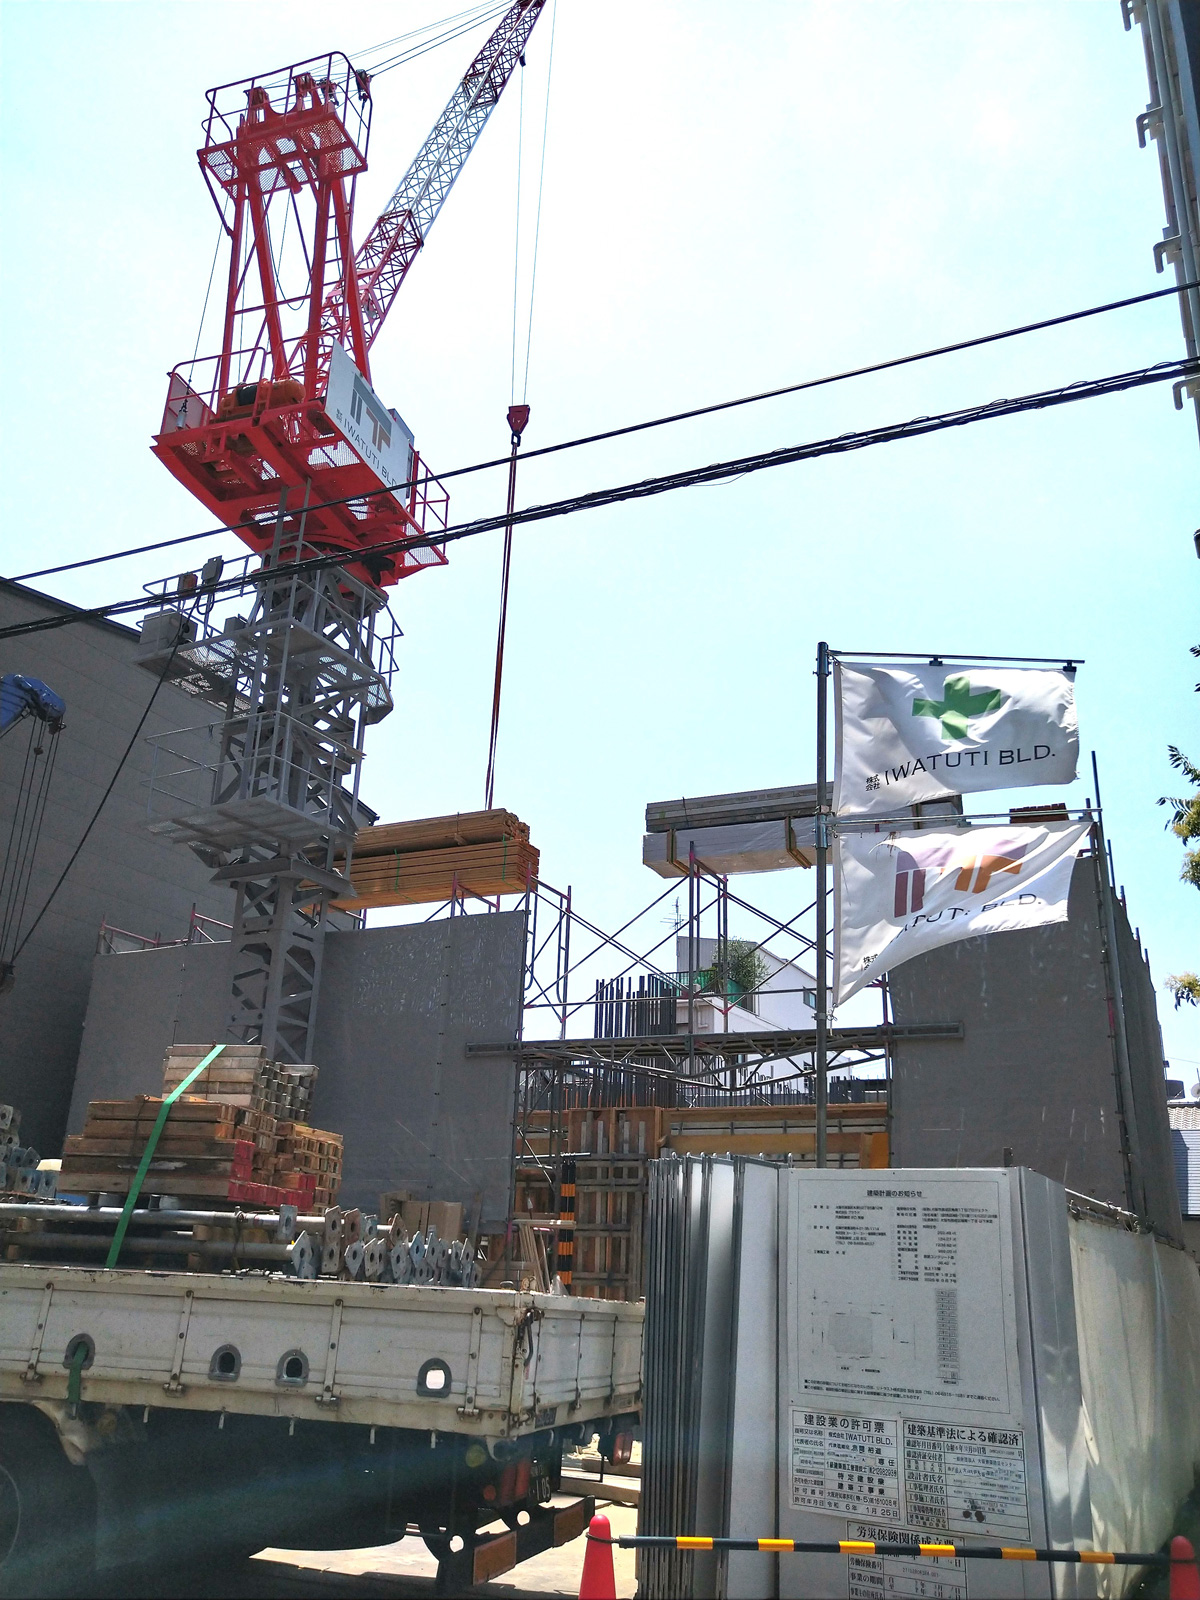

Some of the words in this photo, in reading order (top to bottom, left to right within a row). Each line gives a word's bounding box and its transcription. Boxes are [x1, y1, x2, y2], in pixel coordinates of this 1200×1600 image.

[344, 418, 380, 470] IWATUTI
[885, 751, 989, 786] IWATUTI
[999, 745, 1056, 766] BLD.
[867, 1189, 922, 1198] 建築計画のお知らせ
[804, 1413, 885, 1433] 建設業の許可票
[845, 1432, 874, 1444] IWATUTI
[876, 1436, 893, 1446] BLD.
[907, 1423, 1019, 1446] 建築基準法による確認済
[907, 1472, 944, 1483] 設計者氏名
[794, 1496, 824, 1506] 許可年月日
